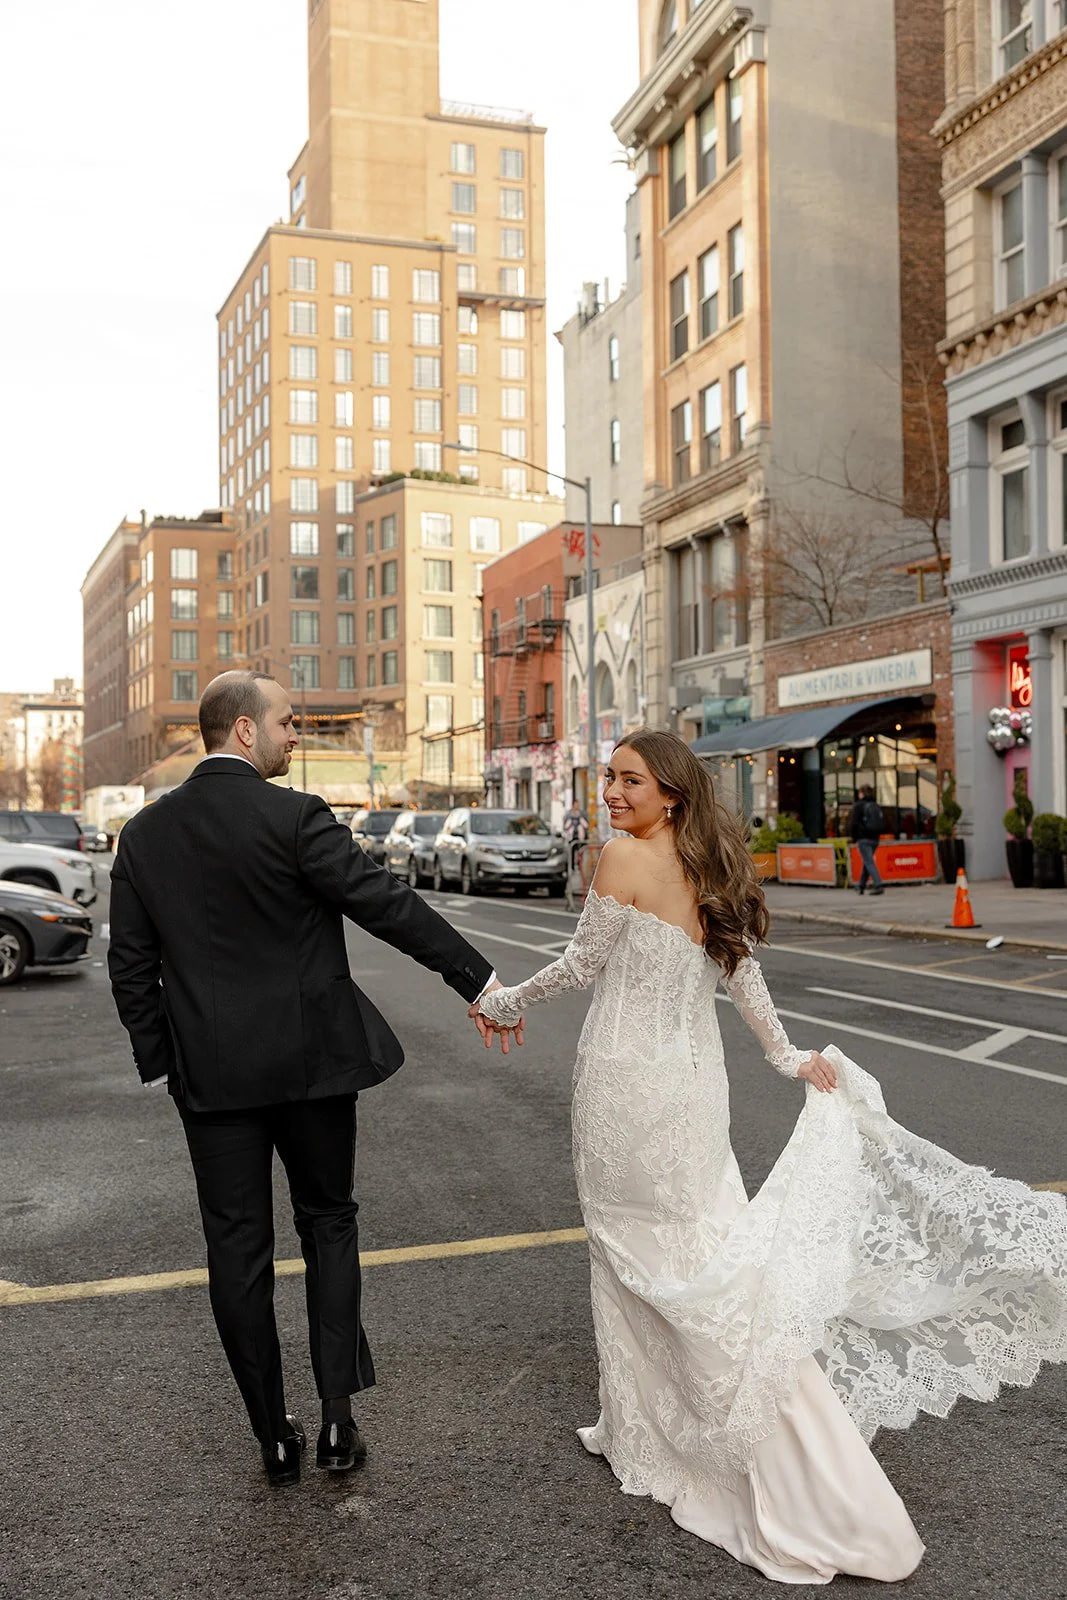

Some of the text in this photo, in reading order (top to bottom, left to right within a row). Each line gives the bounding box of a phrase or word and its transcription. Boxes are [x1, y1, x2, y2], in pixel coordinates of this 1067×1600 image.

[788, 660, 917, 698] ALIMENTARI & VINERIA
